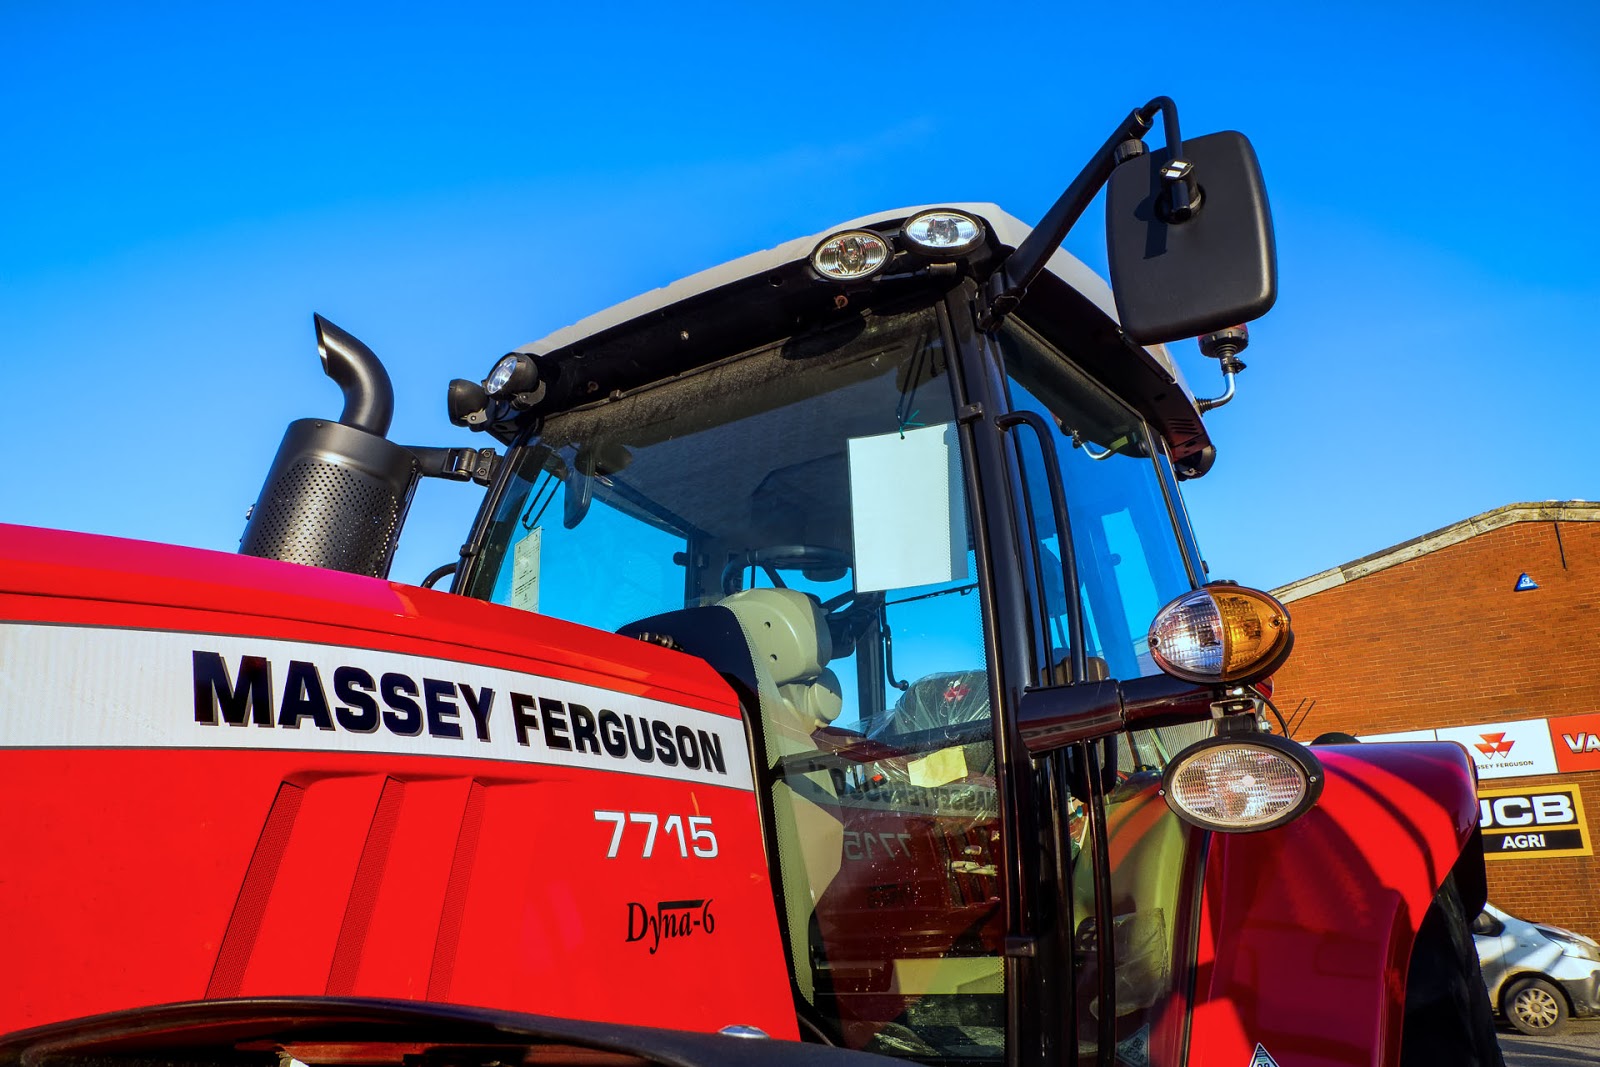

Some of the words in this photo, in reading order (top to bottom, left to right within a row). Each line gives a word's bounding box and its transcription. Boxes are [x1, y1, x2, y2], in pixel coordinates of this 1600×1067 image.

[192, 650, 496, 743] MASSEY
[510, 691, 727, 775] FERGUSON
[1496, 760, 1534, 768] FERGUSON
[1479, 794, 1574, 827] JCB
[593, 810, 719, 859] 7715
[1502, 834, 1546, 849] AGRI
[625, 899, 715, 955] Dyna-6
